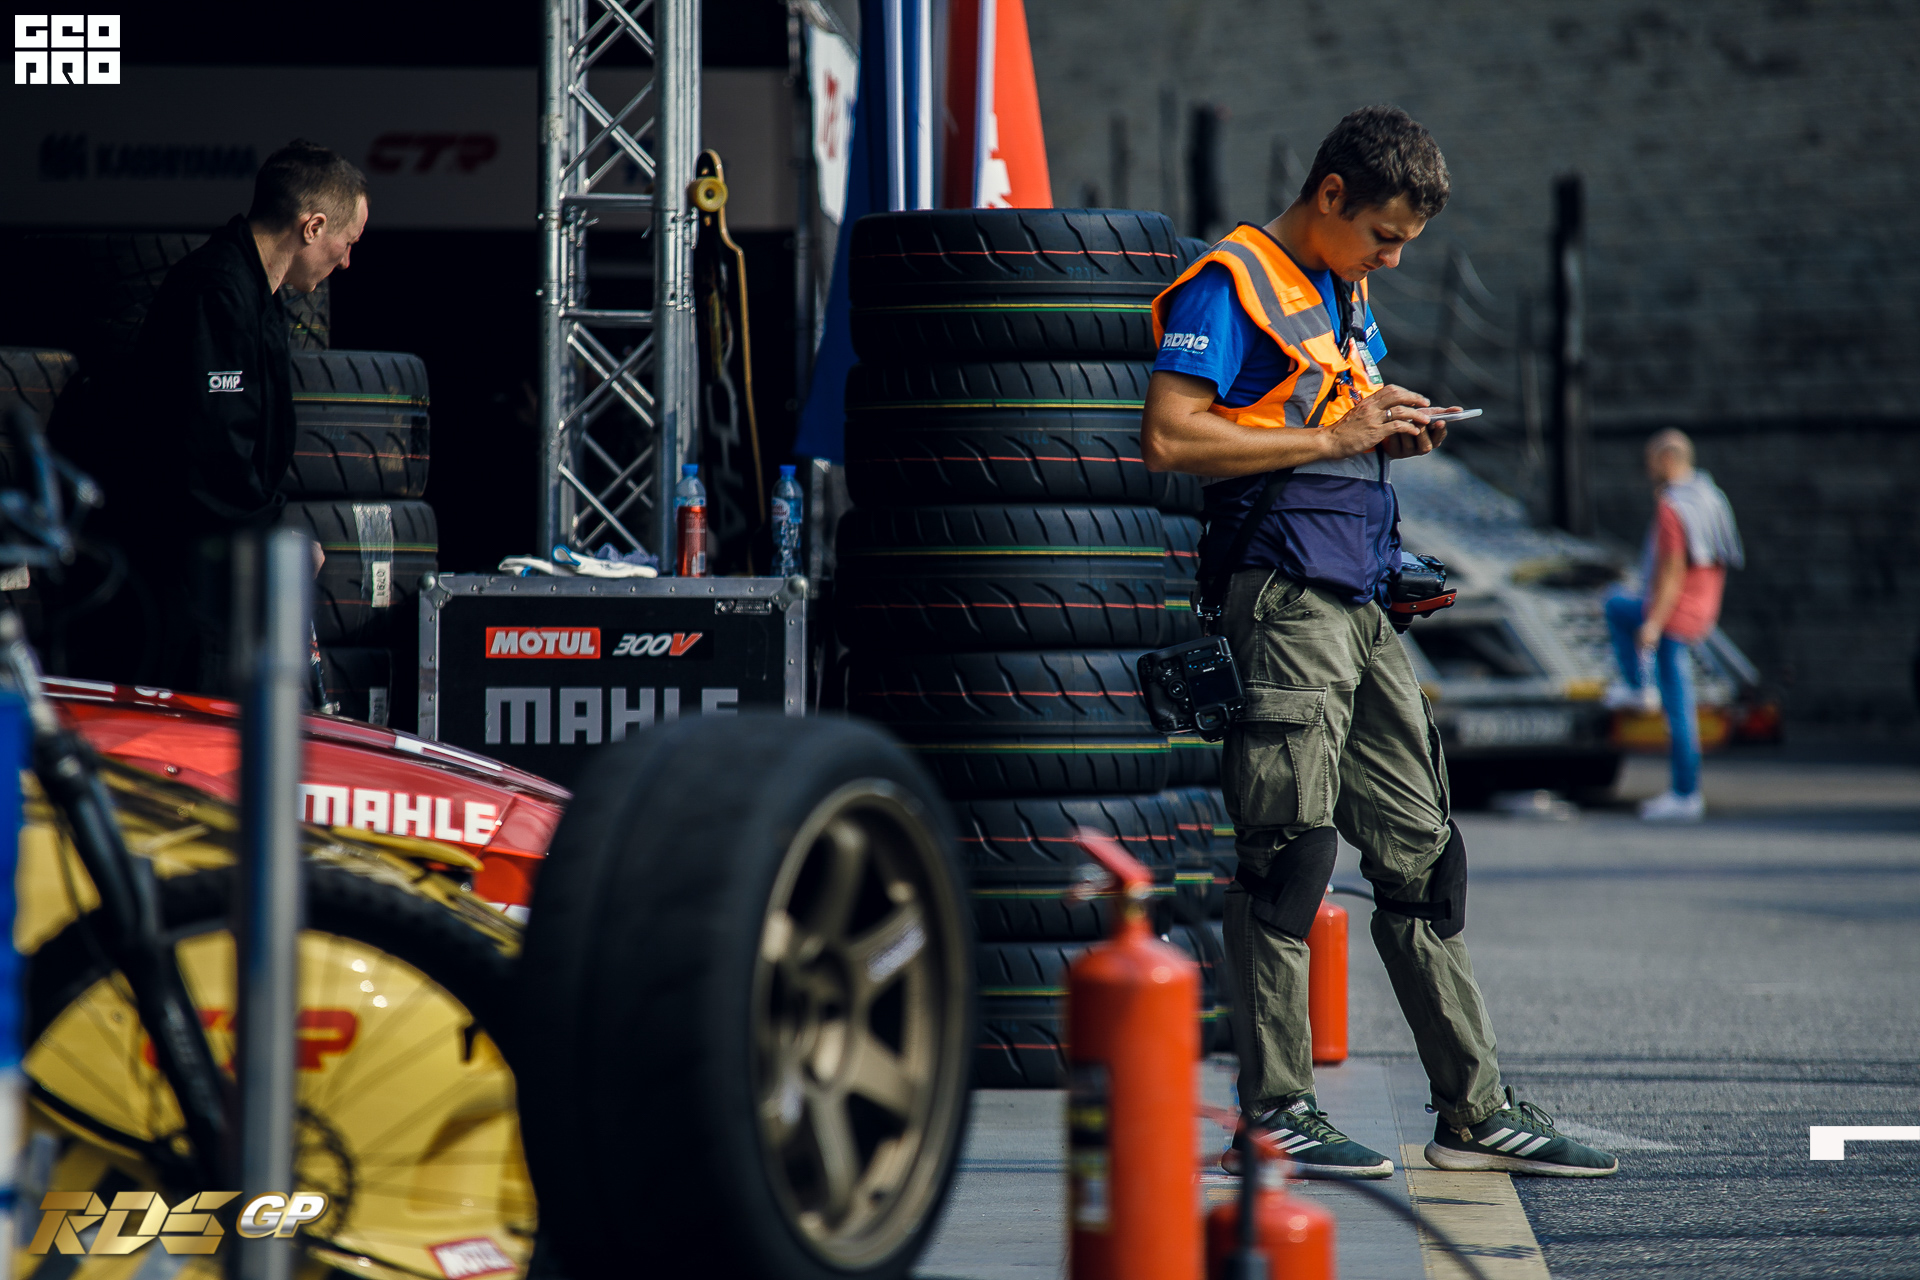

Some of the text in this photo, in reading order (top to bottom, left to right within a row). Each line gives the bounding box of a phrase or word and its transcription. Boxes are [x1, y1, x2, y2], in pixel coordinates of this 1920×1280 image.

[208, 375, 241, 389] OMP
[490, 631, 704, 656] MOTUL 300V
[297, 783, 497, 845] MAHLE
